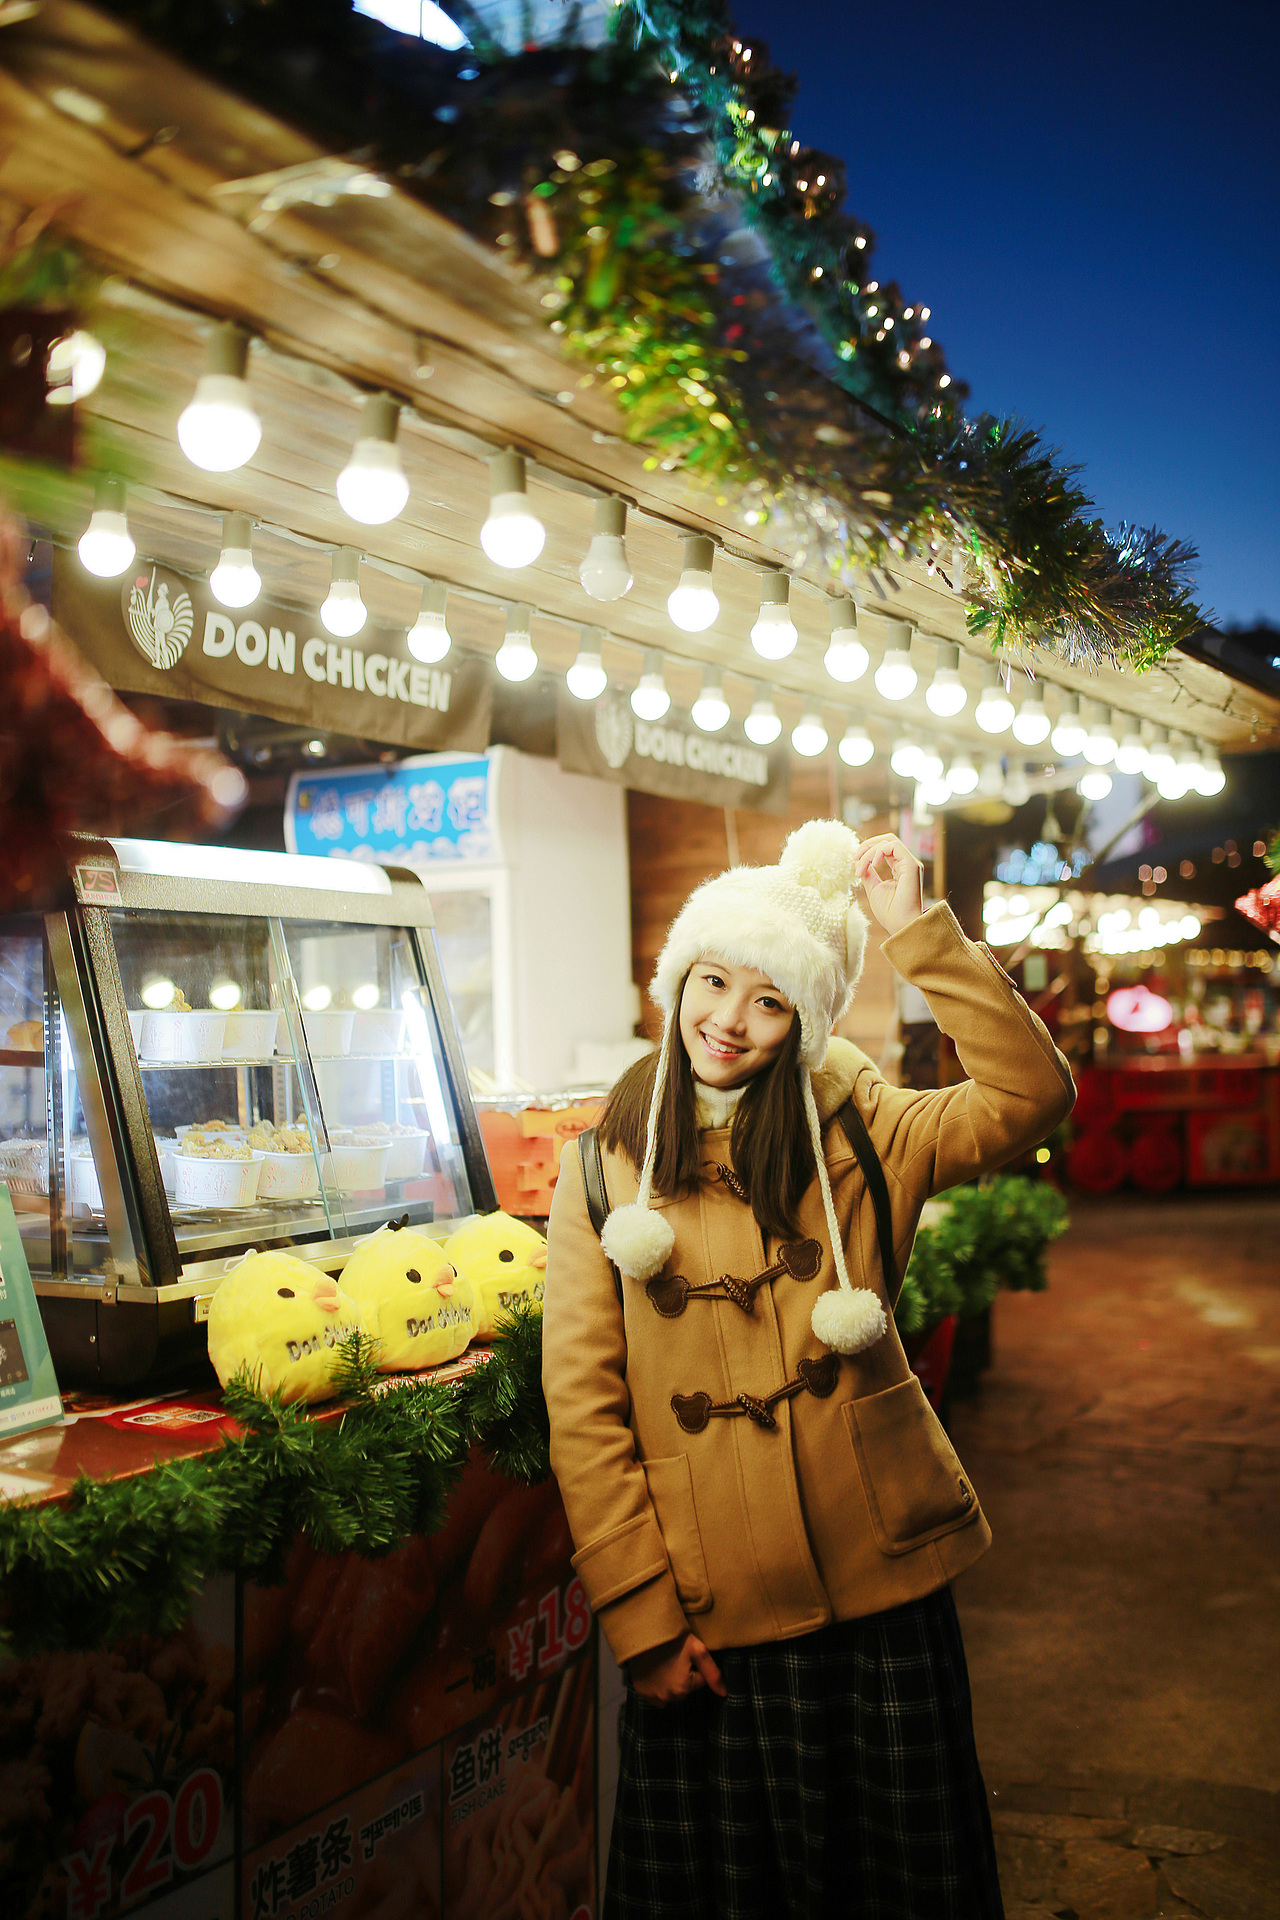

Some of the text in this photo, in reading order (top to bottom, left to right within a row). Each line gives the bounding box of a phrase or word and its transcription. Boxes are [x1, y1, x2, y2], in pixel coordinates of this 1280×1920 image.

[203, 611, 452, 713] DON CHICKEN
[634, 722, 685, 766] DON
[286, 1331, 321, 1364] Don
[407, 1317, 435, 1338] Don
[450, 1727, 502, 1803] 鱼饼
[451, 1776, 507, 1827] FISH CAKE
[60, 1767, 224, 1920] ¥20
[251, 1793, 423, 1920] 炸薯条 컵포테이토
[300, 1875, 354, 1920] POTATO
